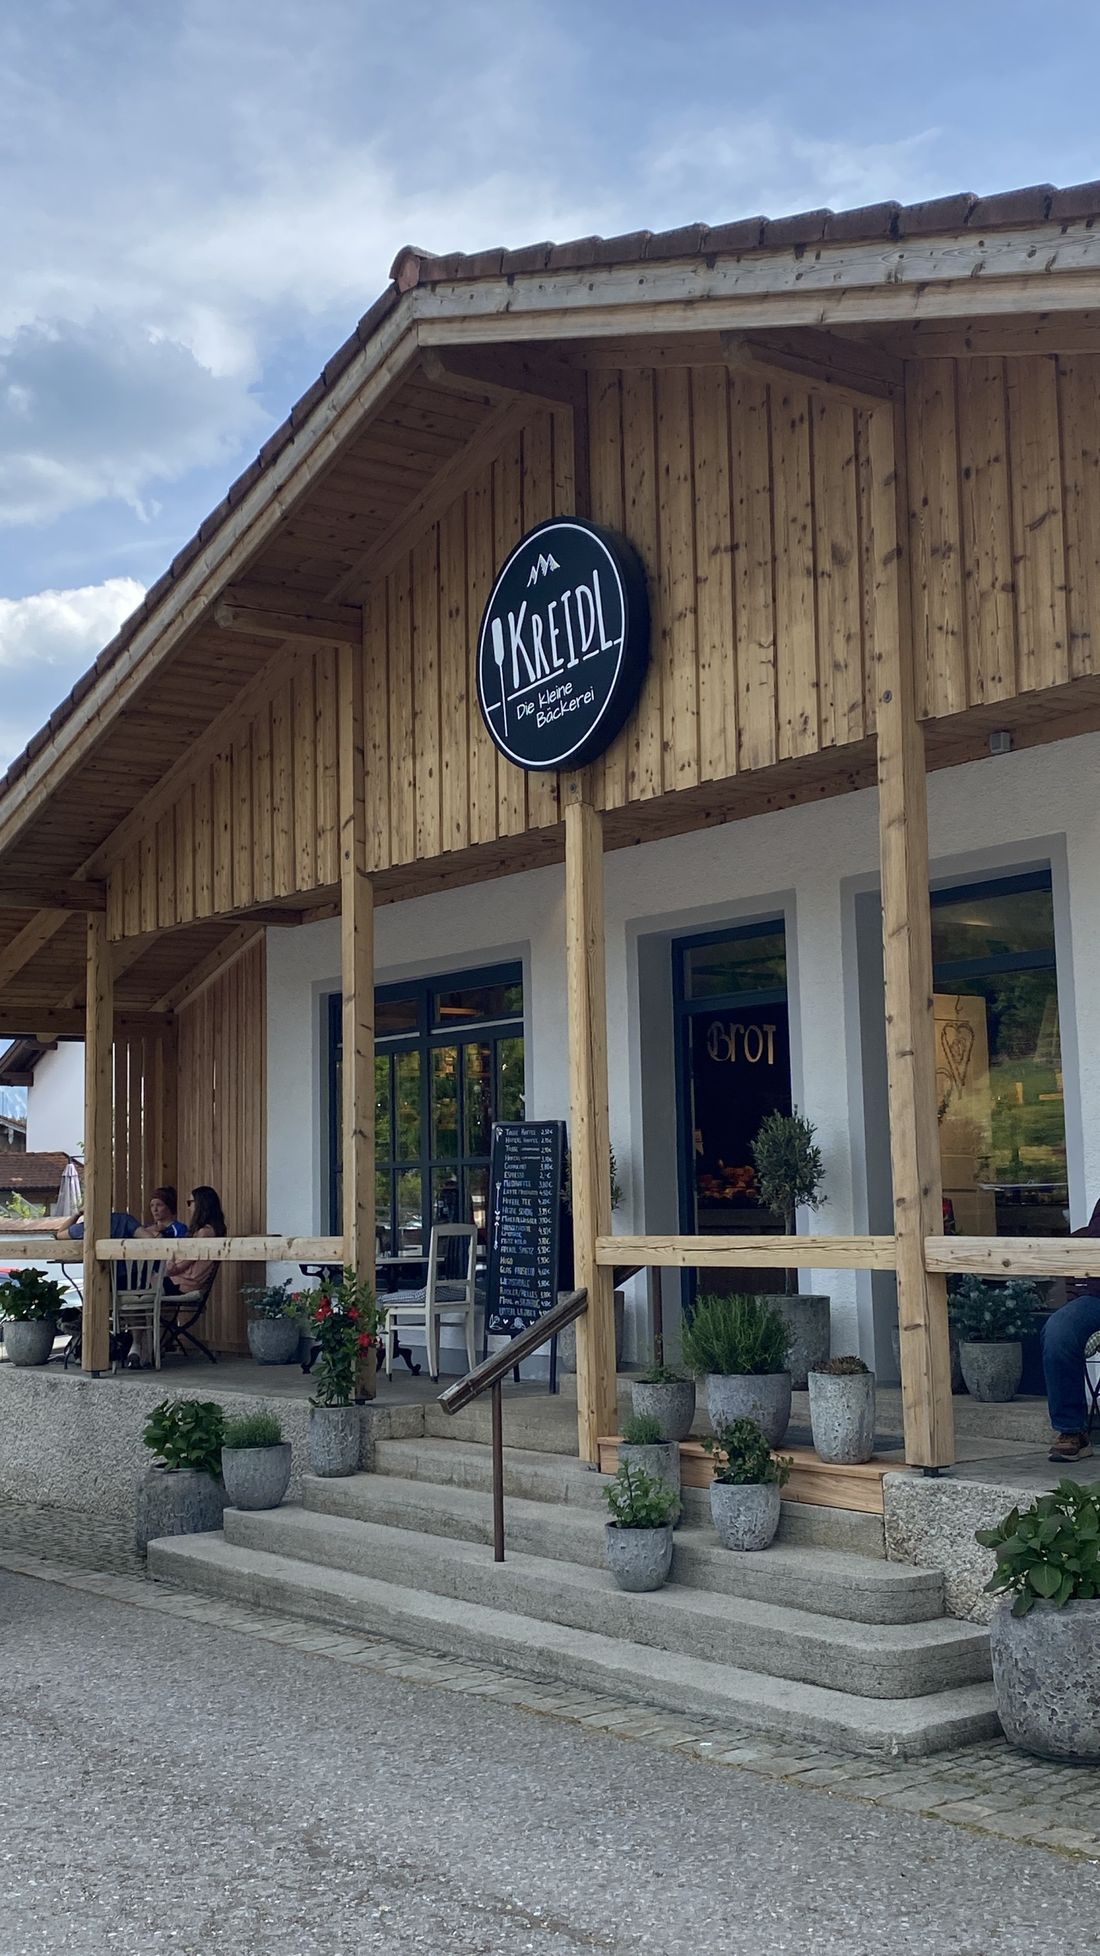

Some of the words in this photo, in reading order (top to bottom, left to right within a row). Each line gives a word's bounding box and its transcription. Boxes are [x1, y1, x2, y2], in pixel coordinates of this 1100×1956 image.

[508, 569, 613, 689] KREIDL
[517, 701, 535, 720] Die
[536, 686, 595, 729] Bäckerei
